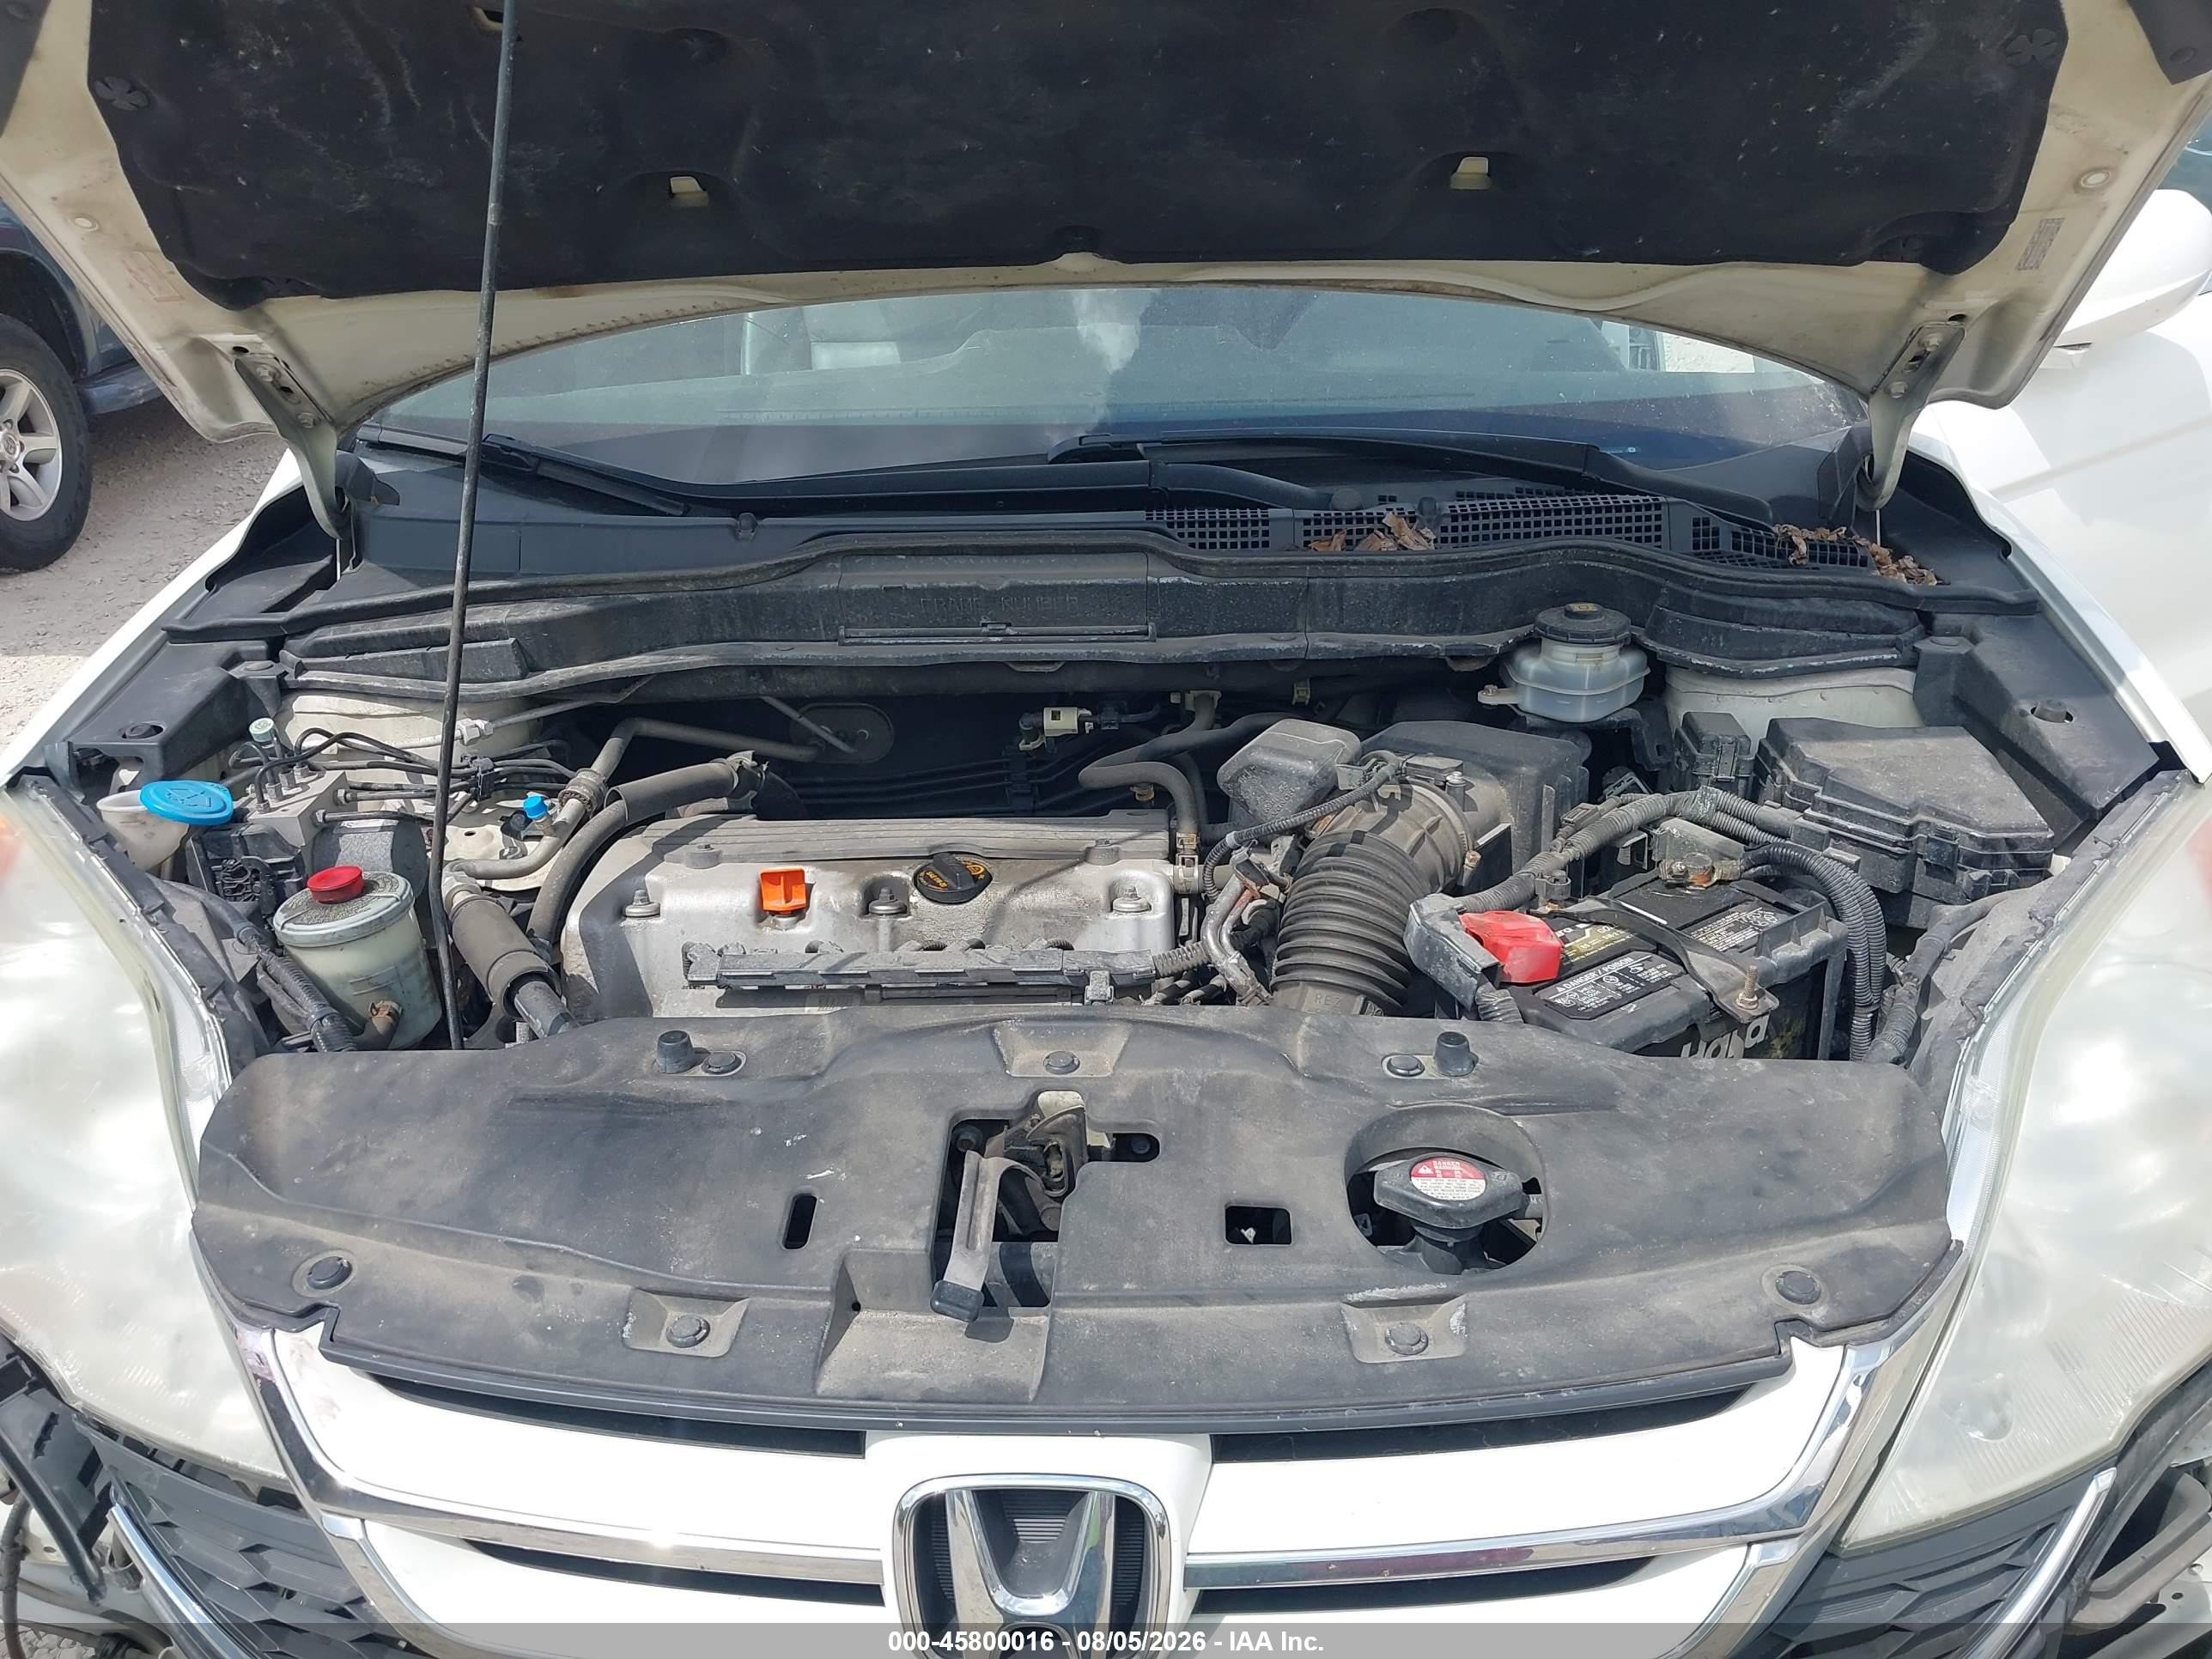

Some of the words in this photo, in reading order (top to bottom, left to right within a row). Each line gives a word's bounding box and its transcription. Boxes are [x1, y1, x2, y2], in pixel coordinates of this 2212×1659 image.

[920, 597, 982, 612] FRAME
[1000, 595, 1079, 611] NUMBER
[1563, 970, 1600, 988] DANGER
[1602, 956, 1635, 973] POISON
